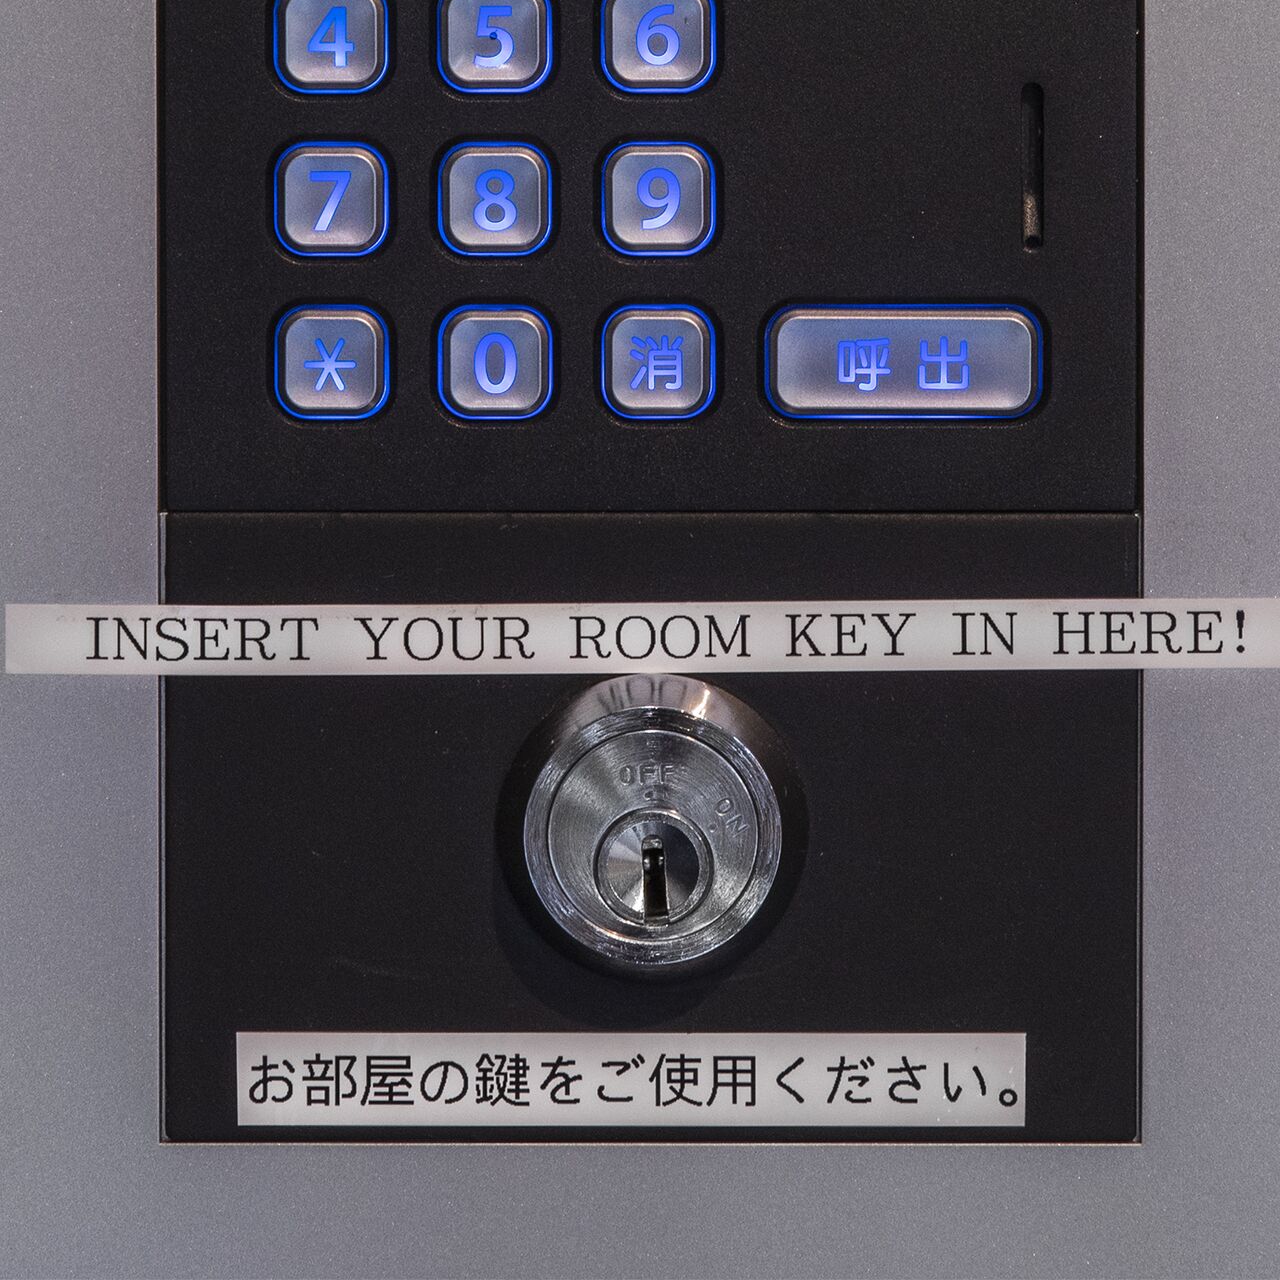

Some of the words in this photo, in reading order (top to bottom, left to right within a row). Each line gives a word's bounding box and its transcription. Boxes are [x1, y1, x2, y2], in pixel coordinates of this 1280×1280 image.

[306, 5, 356, 68] 4
[473, 4, 515, 68] 5
[634, 2, 681, 67] 6
[307, 169, 353, 233] 7
[472, 168, 519, 232] 8
[635, 166, 682, 231] 9
[472, 331, 520, 394] 0
[628, 334, 686, 392] 消
[835, 335, 972, 393] 呼出
[84, 616, 320, 662] INSERT
[353, 616, 536, 662] YOUR
[568, 614, 752, 660] ROOM
[784, 612, 917, 657] KEY
[951, 611, 1018, 656] IN
[1052, 609, 1247, 655] HERE!
[619, 762, 675, 787] OFF
[714, 797, 752, 839] ON
[247, 1051, 1019, 1108] お部屋の鍵をご使用ください。
